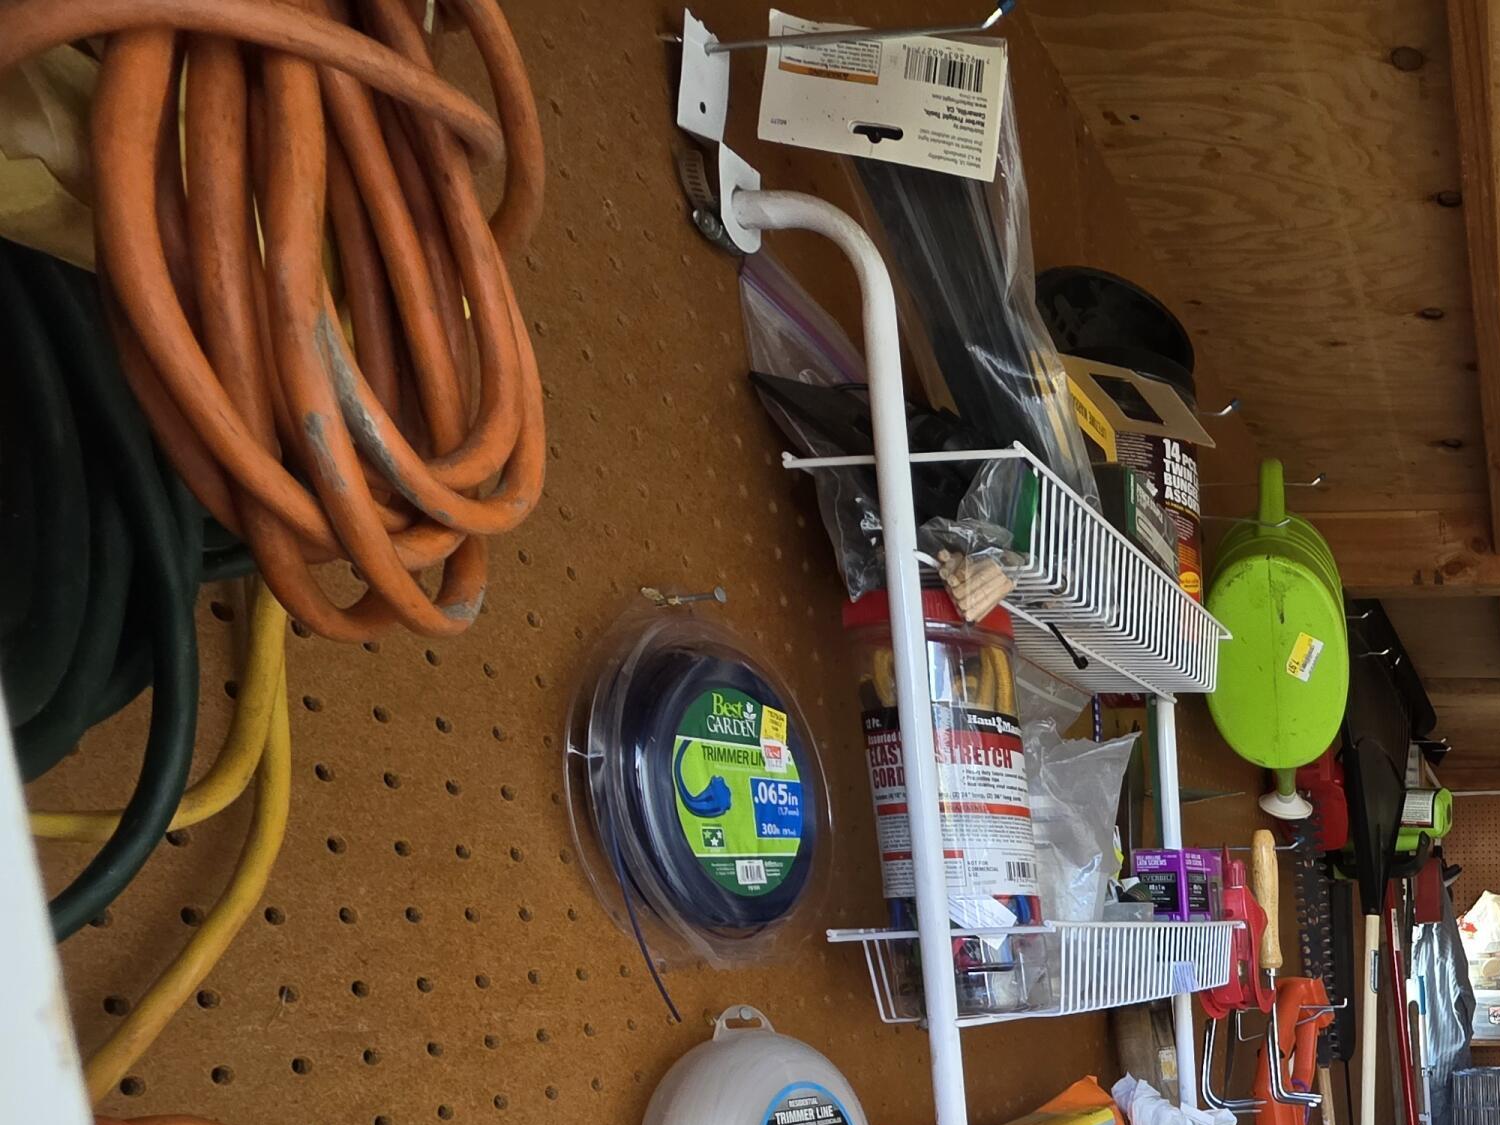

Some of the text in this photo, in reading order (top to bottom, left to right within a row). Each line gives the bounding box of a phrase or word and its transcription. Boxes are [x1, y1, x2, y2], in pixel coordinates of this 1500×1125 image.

[942, 113, 964, 123] Freight
[965, 118, 985, 127] Harbor
[1162, 438, 1181, 463] 14
[1162, 458, 1193, 483] TWIN
[711, 692, 744, 719] Best
[706, 714, 756, 738] GARDEN
[701, 744, 750, 766] TRIMMER
[750, 750, 767, 767] LIN
[775, 1105, 834, 1125] TRIMMER LINE
